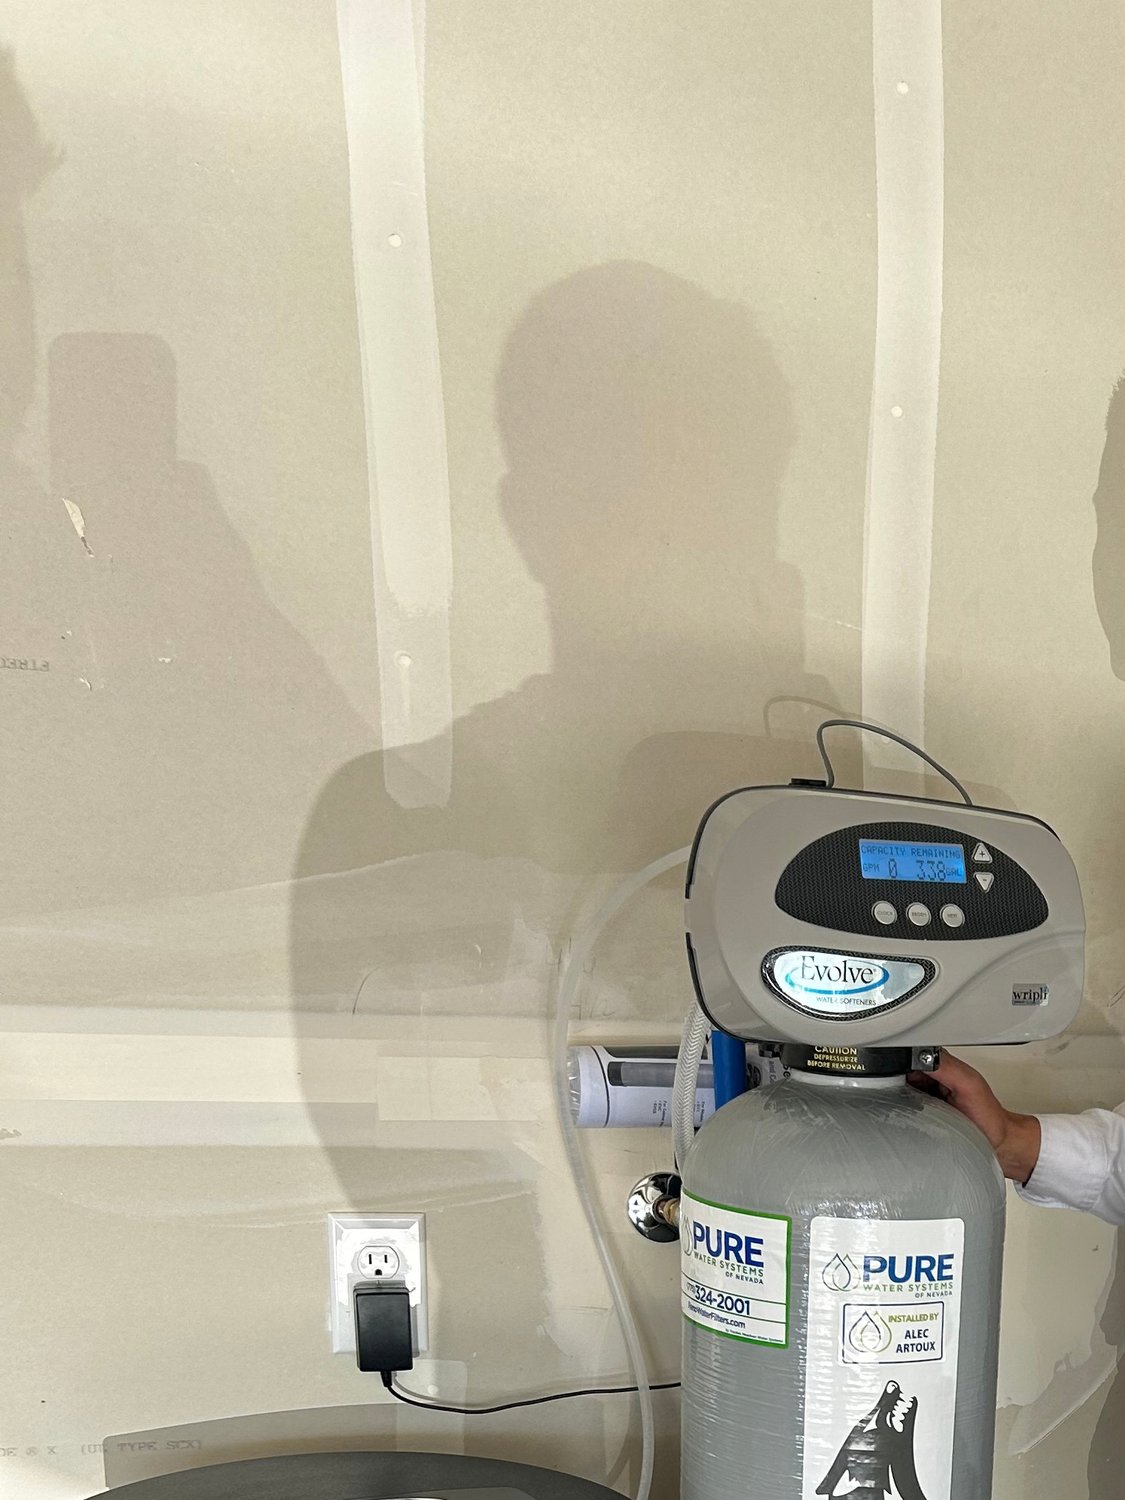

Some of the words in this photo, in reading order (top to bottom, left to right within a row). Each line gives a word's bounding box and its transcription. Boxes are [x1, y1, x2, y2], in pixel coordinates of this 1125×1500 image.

[861, 846, 906, 856] CAPACITY
[911, 848, 961, 859] REMAINING
[863, 863, 880, 872] GPM
[888, 858, 898, 878] 0
[916, 860, 946, 881] 338
[802, 956, 874, 984] Evolve
[840, 998, 877, 1006] SOFTENERS
[815, 1046, 857, 1055] CAUTION
[814, 1054, 858, 1062] DEPRESSURIZE
[807, 1060, 831, 1068] BEFORE
[831, 1062, 866, 1071] REMOVAL
[693, 1220, 764, 1268] PURE
[694, 1252, 716, 1266] WATER
[720, 1260, 764, 1278] SYSTEMS
[863, 1253, 954, 1282] PURE
[736, 1274, 764, 1285] NEVADA
[863, 1283, 905, 1293] WATER
[908, 1281, 953, 1292] SYSTEMS
[695, 1285, 750, 1315] 324-2001
[925, 1290, 953, 1298] NEVADA
[888, 1312, 928, 1323] INSTALLED
[928, 1312, 940, 1321] BY
[904, 1328, 930, 1340] ALEC
[896, 1342, 936, 1354] ARTOUX
